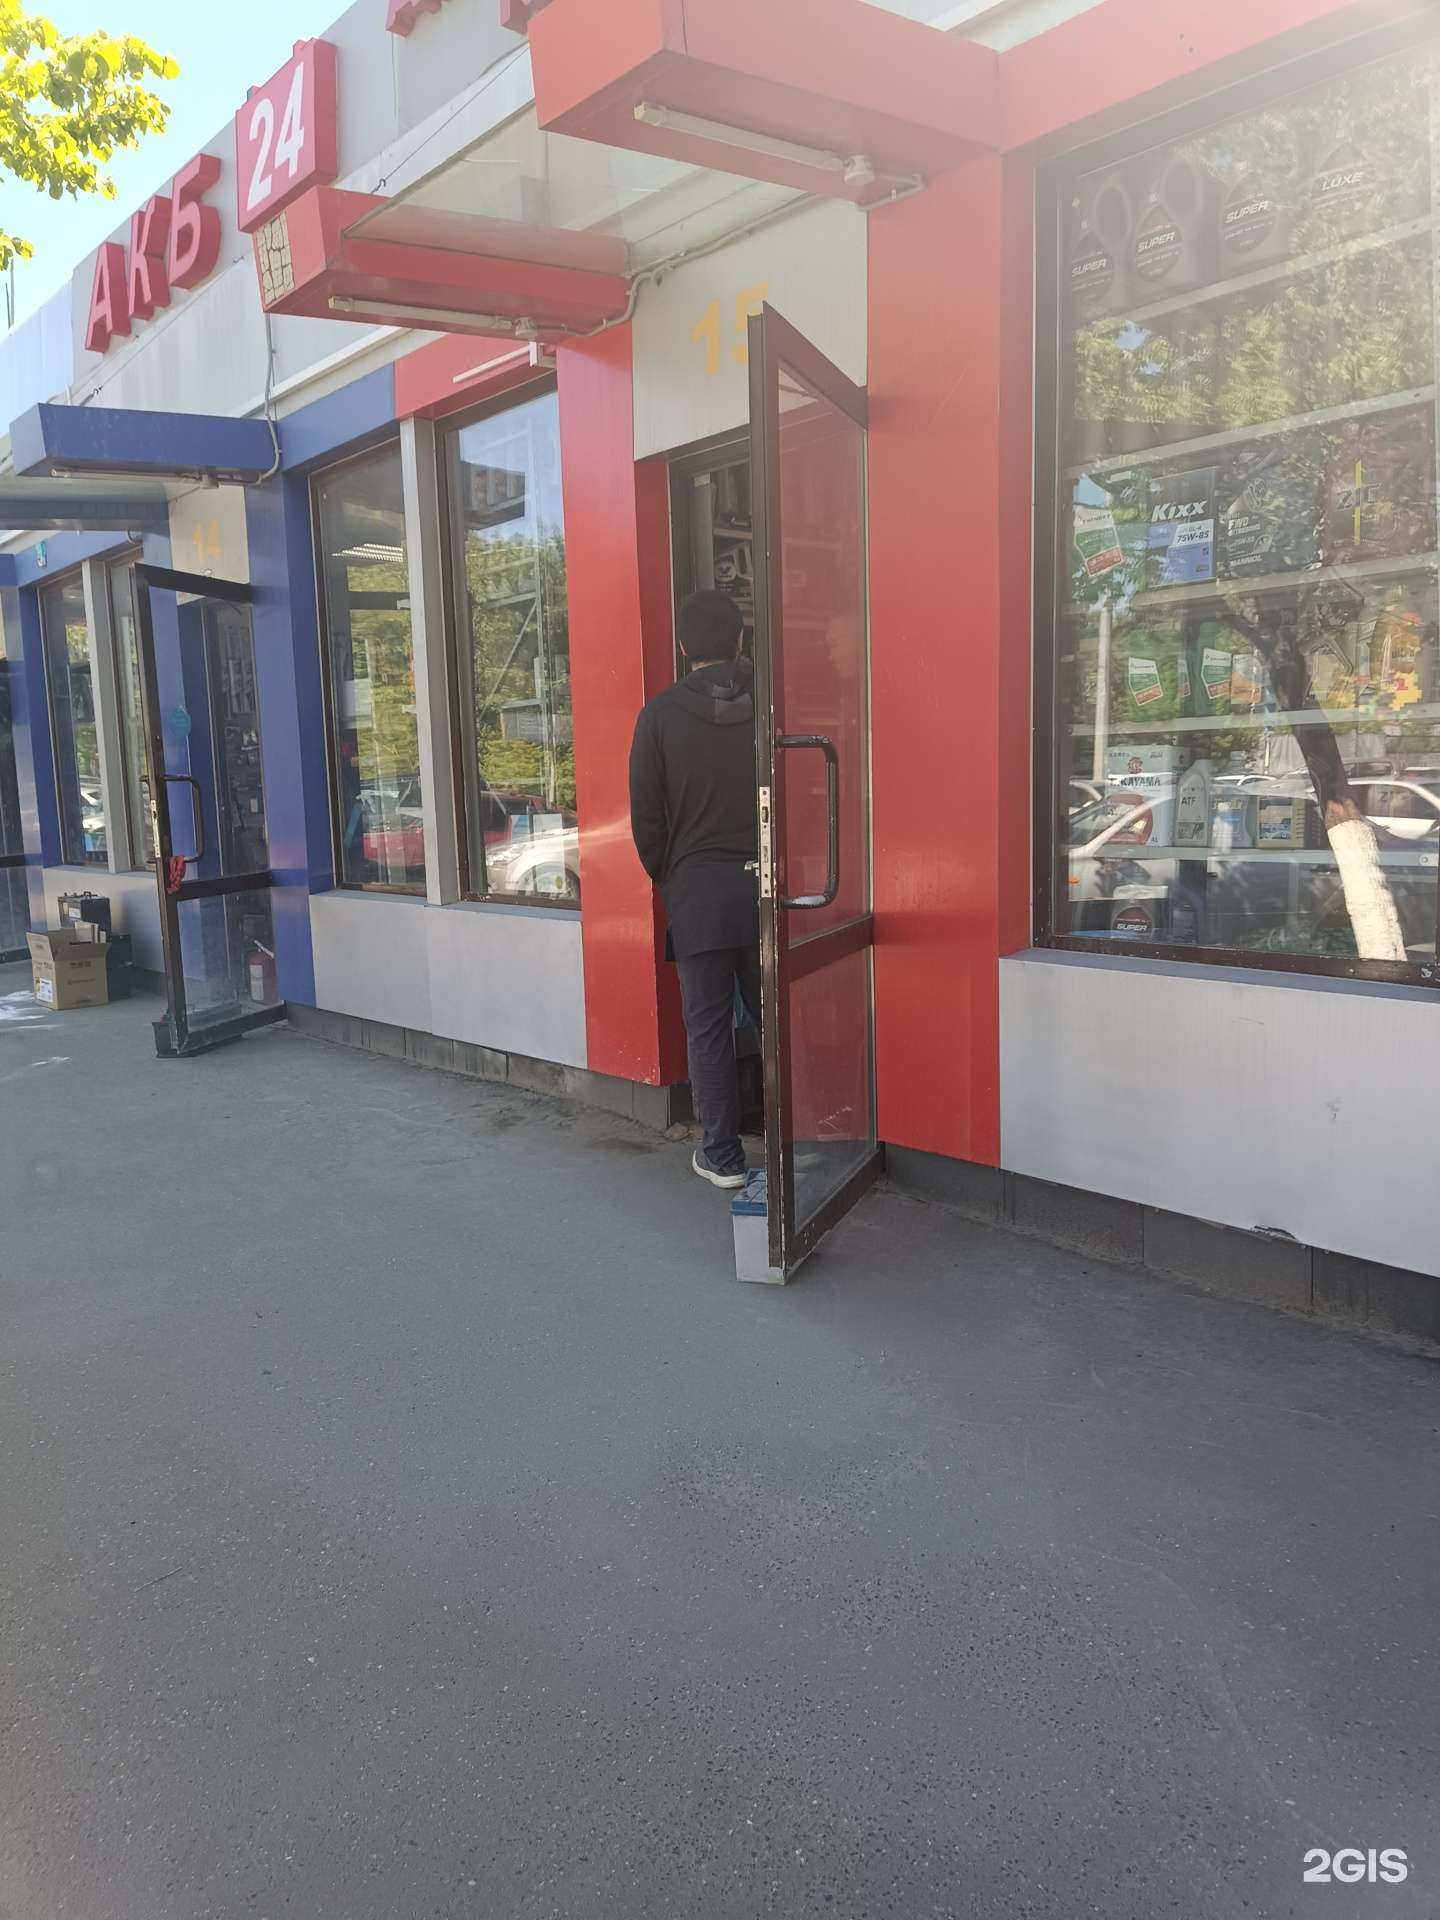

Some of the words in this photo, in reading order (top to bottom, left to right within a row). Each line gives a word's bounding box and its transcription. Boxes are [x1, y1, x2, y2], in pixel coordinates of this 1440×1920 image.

[1321, 171, 1364, 191] LUXE
[84, 153, 221, 353] АКБ
[246, 62, 305, 213] 24
[1225, 199, 1269, 224] SUPER
[1137, 231, 1175, 254] SUPER
[1072, 258, 1107, 278] SUPER
[1151, 499, 1207, 523] Kixx
[192, 519, 223, 562] 14
[1177, 530, 1210, 545] 75W-85
[1110, 775, 1161, 787] KAYAMA
[1181, 796, 1196, 806] ATF
[1117, 922, 1148, 932] SUPER
